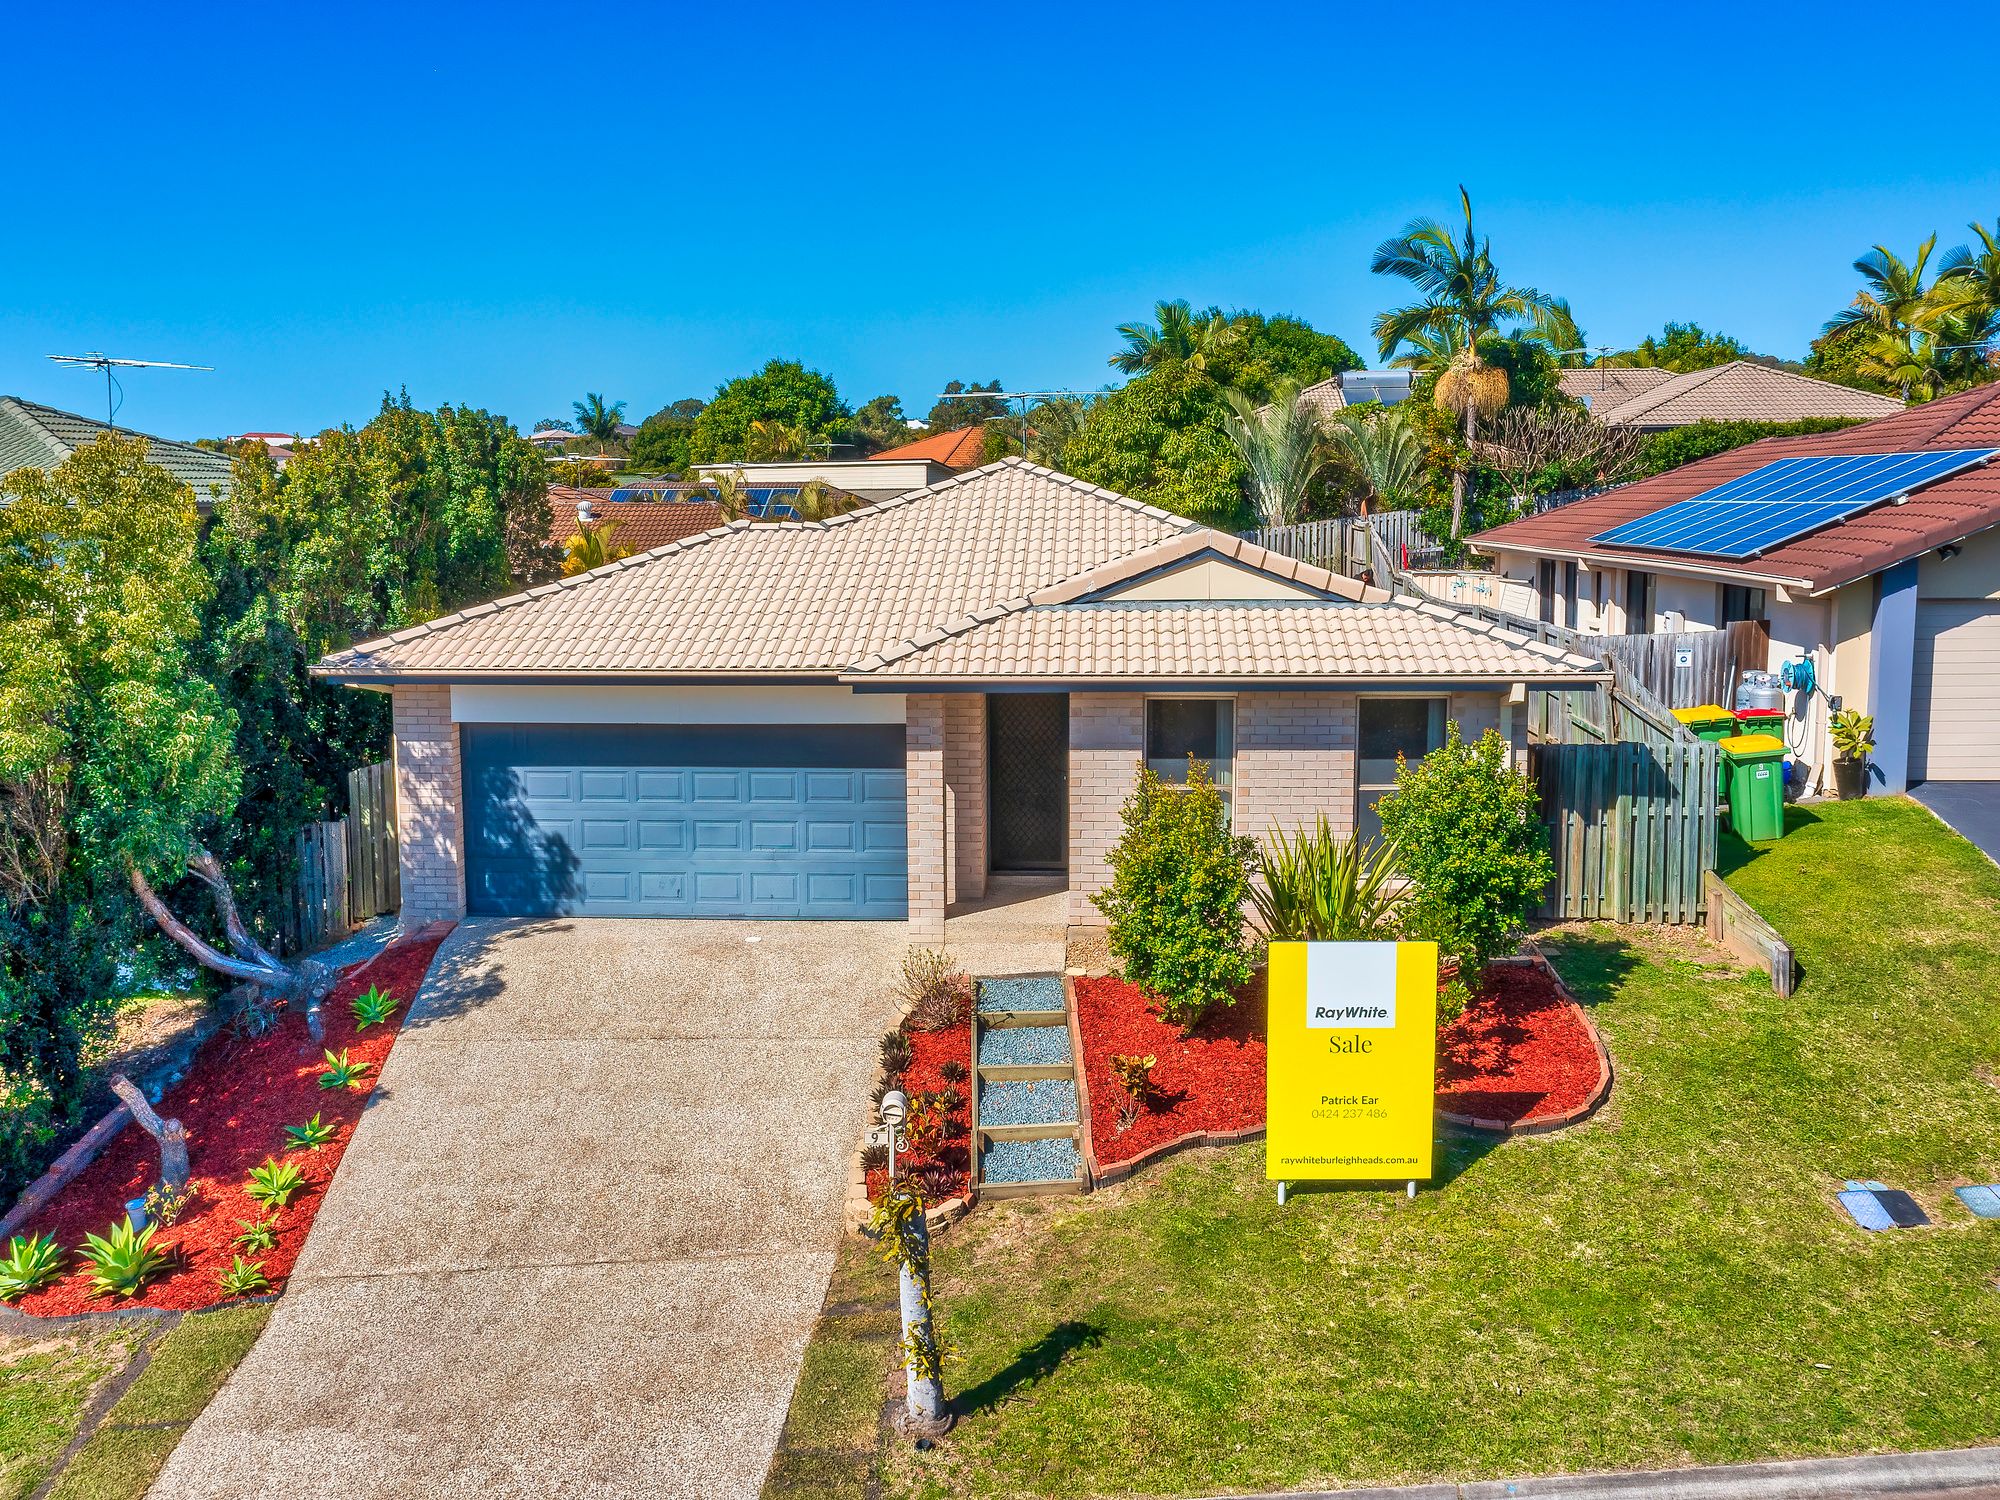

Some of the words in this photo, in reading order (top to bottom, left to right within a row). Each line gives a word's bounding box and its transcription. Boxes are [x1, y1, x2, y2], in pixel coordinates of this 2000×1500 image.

[1329, 1034, 1373, 1054] Sale
[1321, 1095, 1358, 1105] Patrick
[1361, 1095, 1379, 1105] Ear
[1311, 1109, 1339, 1119] 0424
[1342, 1109, 1363, 1119] 237
[1366, 1109, 1388, 1119] 486
[871, 1132, 879, 1143] 9
[1280, 1156, 1418, 1165] raywhiteburleighheads.com.au
